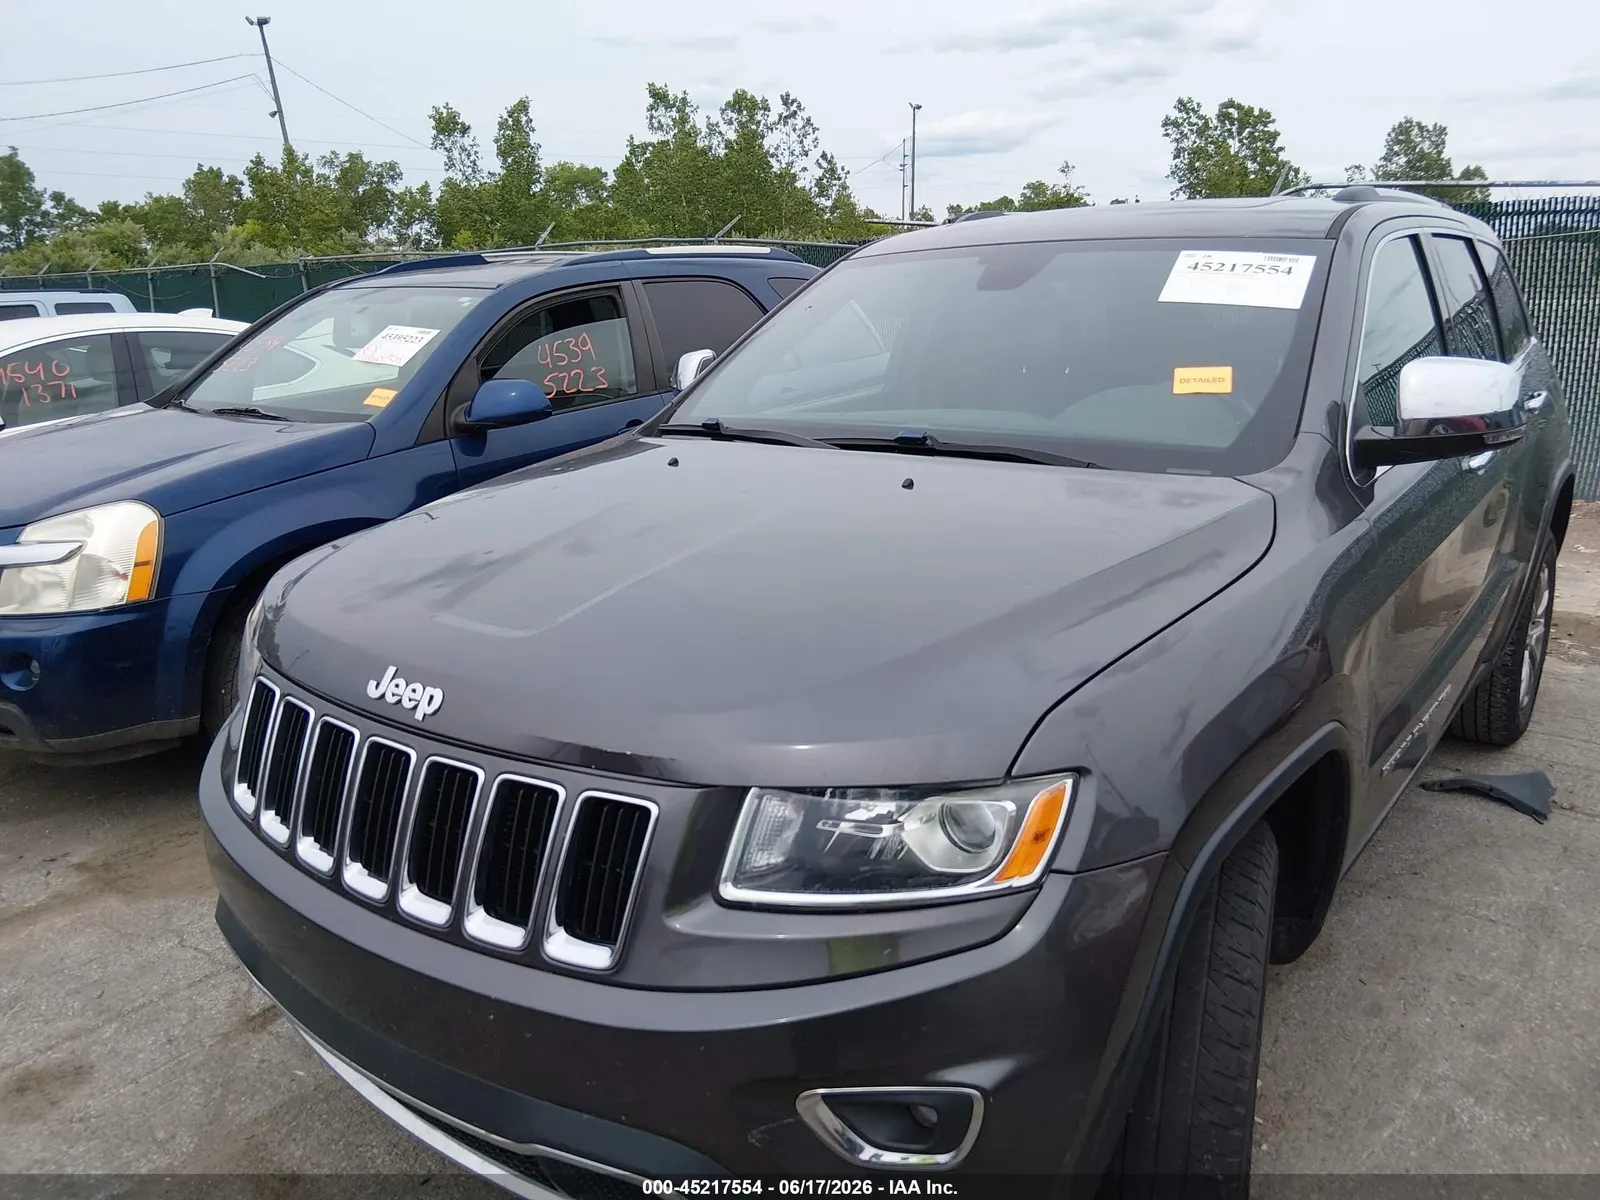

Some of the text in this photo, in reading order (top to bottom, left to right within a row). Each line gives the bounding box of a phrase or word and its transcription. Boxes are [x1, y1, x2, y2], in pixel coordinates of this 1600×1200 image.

[1186, 261, 1294, 276] 45217554
[537, 331, 597, 369] 4539
[21, 380, 78, 408] 1371
[543, 365, 609, 399] 5223
[1179, 376, 1226, 384] DETAILED
[366, 664, 444, 722] Jeep
